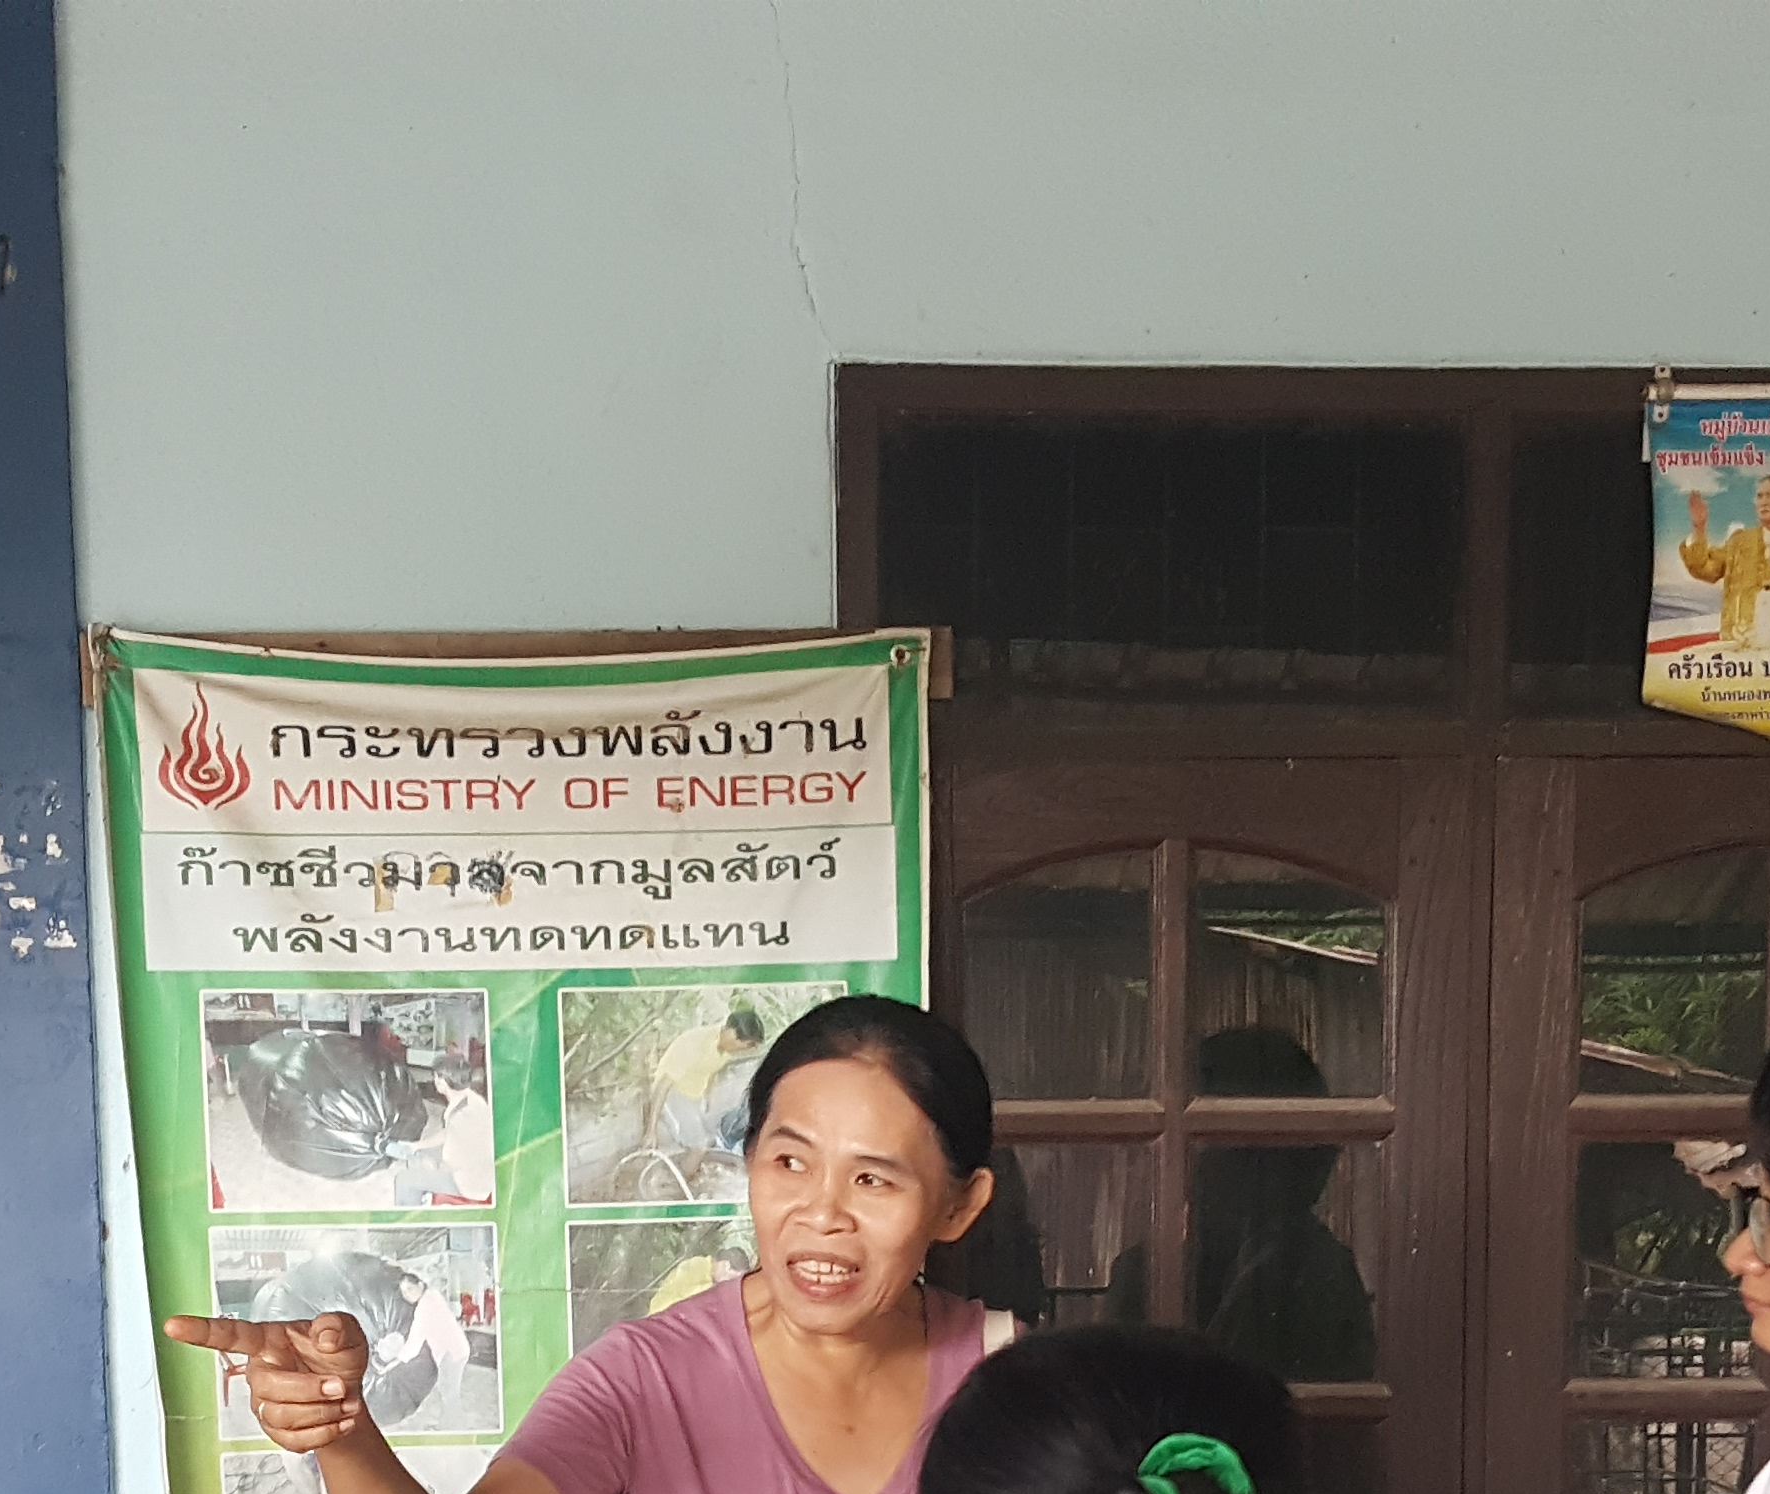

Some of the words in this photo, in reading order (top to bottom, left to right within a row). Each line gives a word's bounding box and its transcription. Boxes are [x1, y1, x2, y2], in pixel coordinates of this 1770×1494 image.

[1668, 654, 1754, 680] ครัวเรือน
[270, 710, 867, 761] กระทรวงพลังงาน
[273, 776, 538, 811] MINISTRY
[563, 777, 629, 810] OF
[657, 770, 868, 812] ENERGY
[232, 913, 791, 954] พลังงานทดทดแทน
